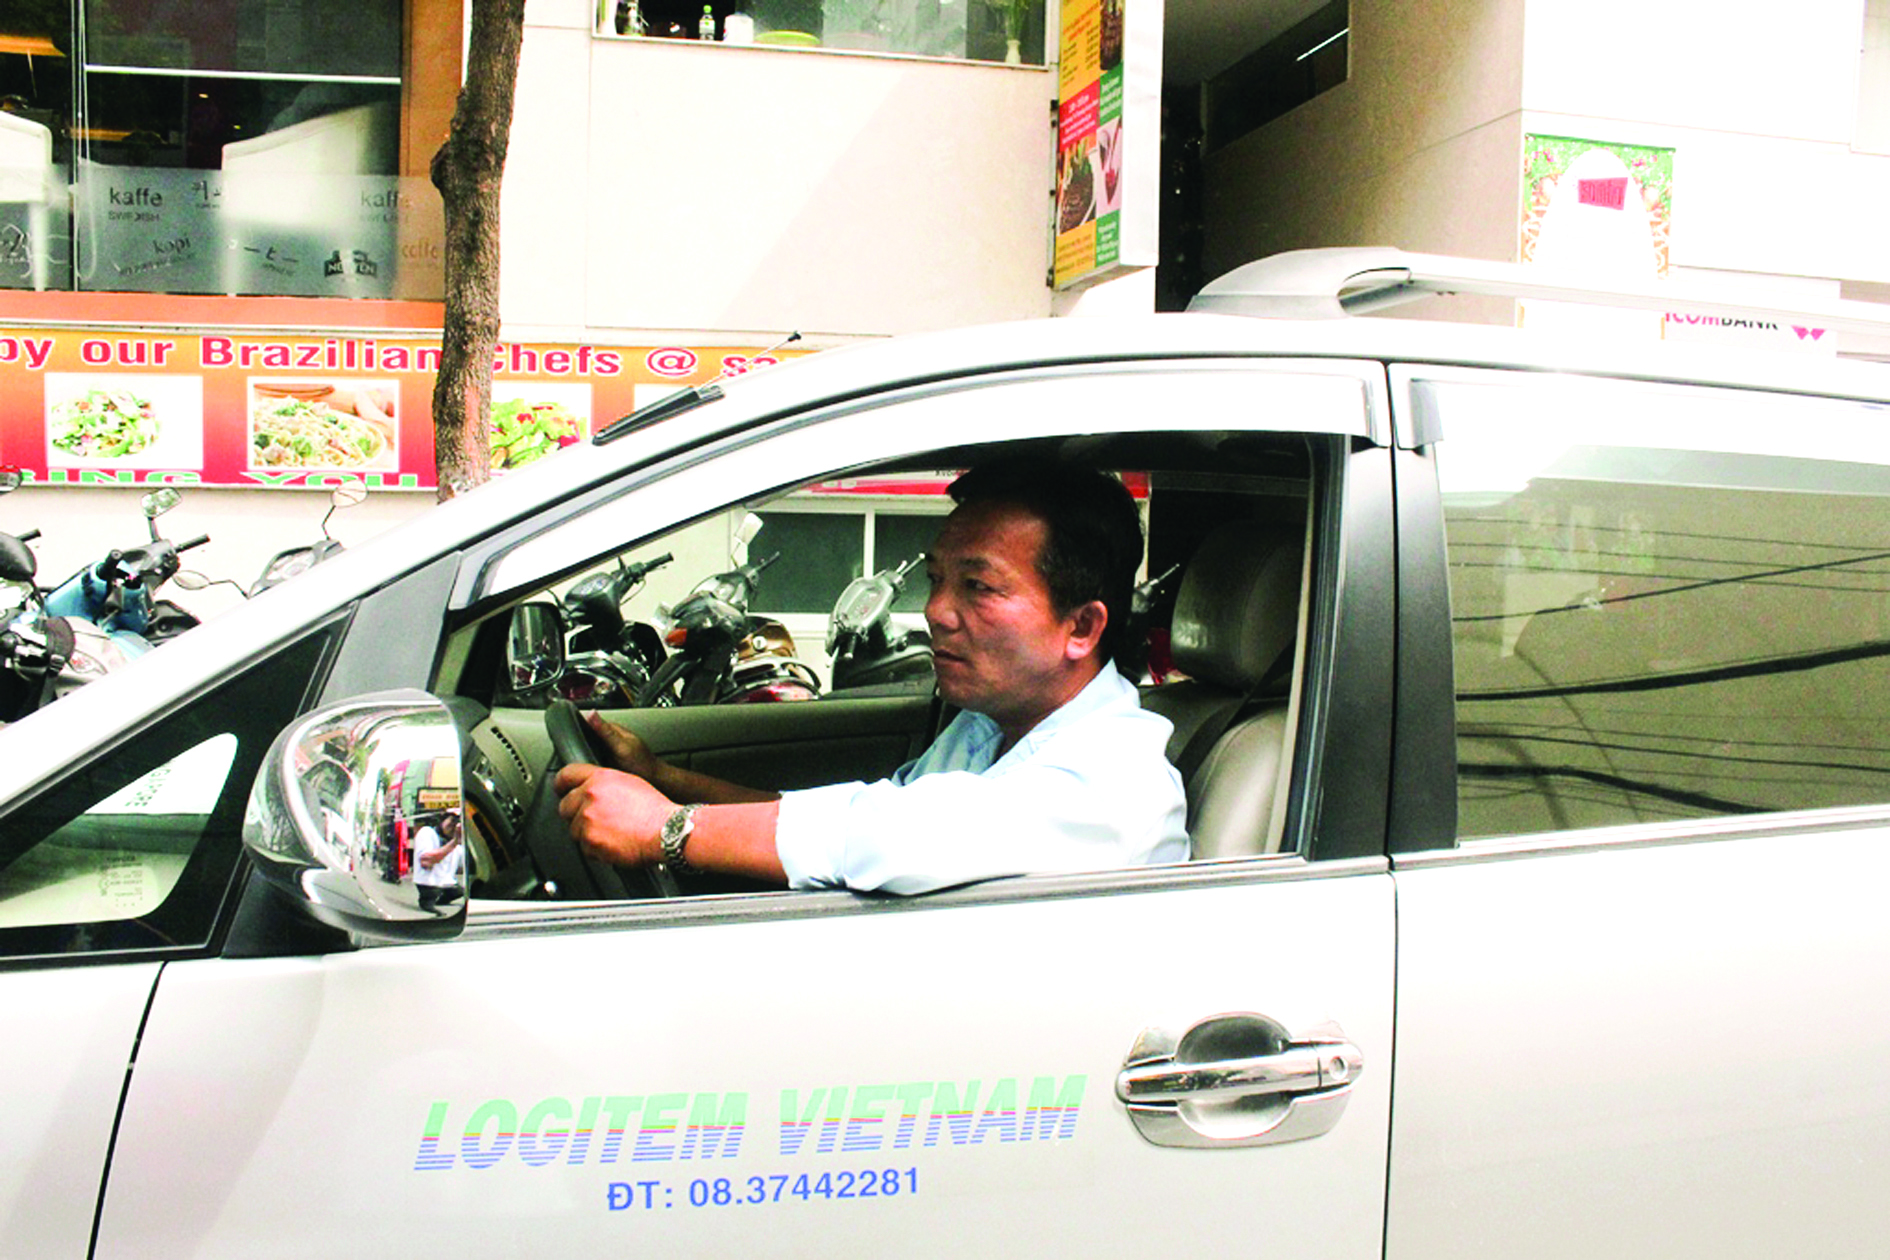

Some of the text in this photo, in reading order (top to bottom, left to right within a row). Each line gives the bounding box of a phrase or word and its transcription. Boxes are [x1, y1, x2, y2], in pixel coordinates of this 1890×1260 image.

[109, 186, 163, 208] kaffe
[82, 340, 173, 366] our
[202, 337, 443, 370] Brazilian
[646, 346, 697, 376] @
[413, 1073, 1088, 1171] LOGITEM VIETNAM
[607, 1166, 918, 1212] ĐT: 08.37442281
